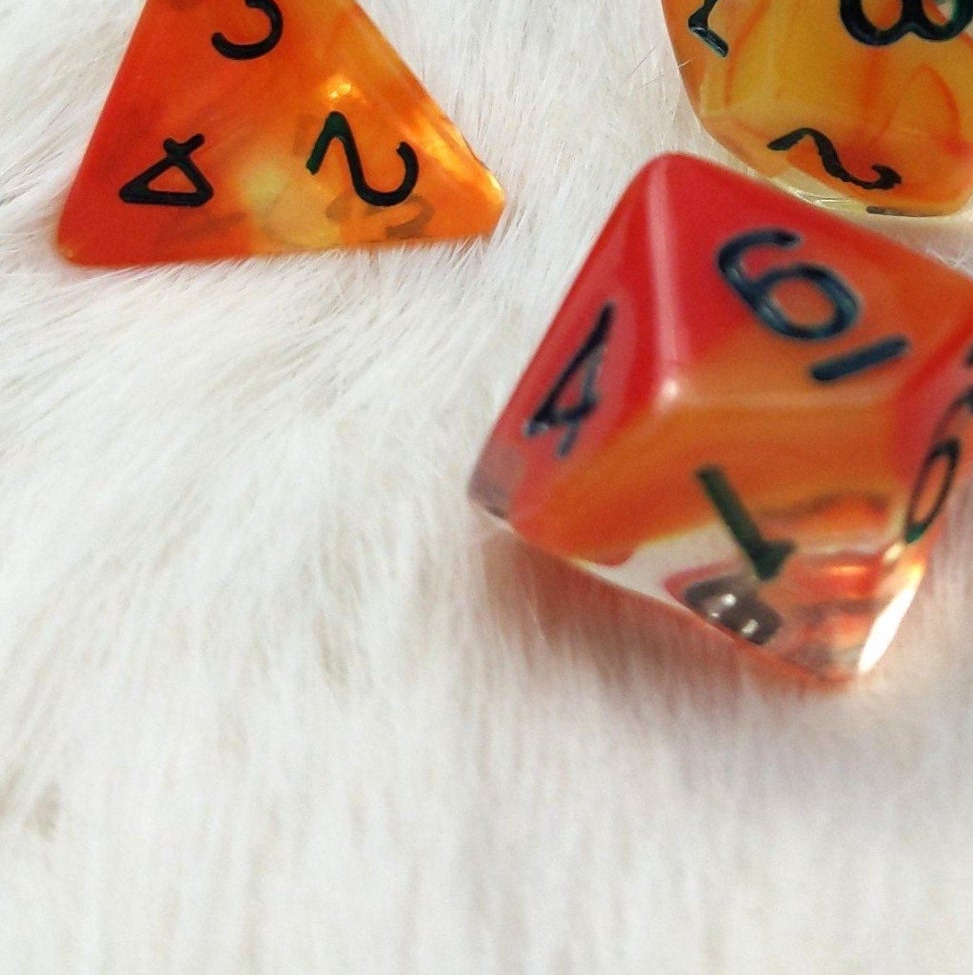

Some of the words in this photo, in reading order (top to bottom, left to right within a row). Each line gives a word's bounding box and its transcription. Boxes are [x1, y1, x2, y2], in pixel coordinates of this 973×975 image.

[119, 133, 214, 207] 4
[306, 110, 419, 206] 2
[767, 127, 902, 191] 2
[523, 301, 616, 459] 4
